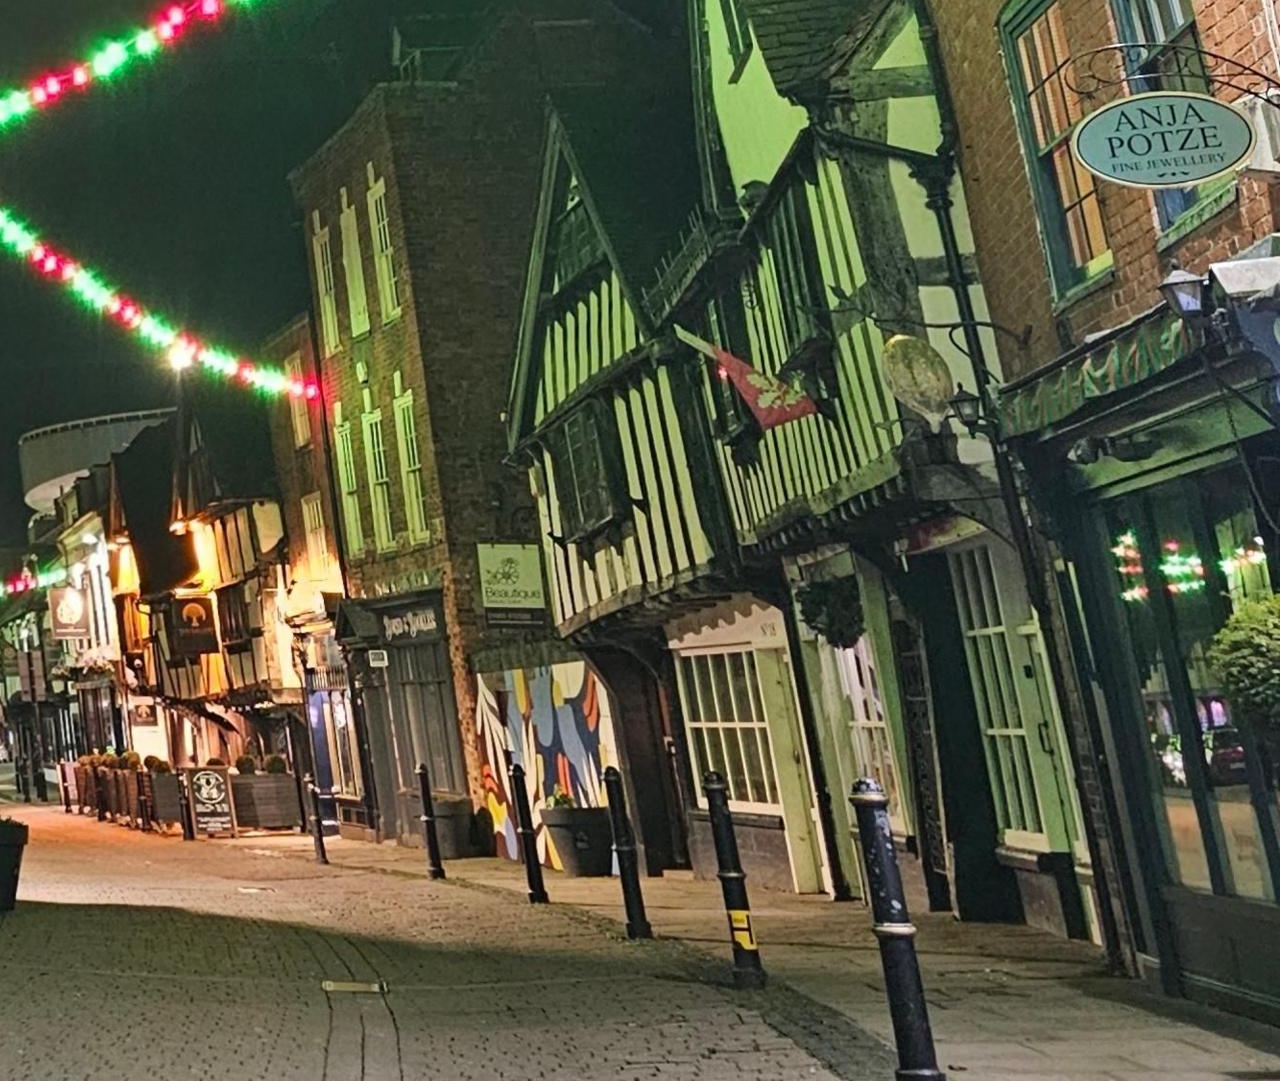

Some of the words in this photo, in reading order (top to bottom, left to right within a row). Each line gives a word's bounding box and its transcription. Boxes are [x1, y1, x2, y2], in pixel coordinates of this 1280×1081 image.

[1113, 101, 1208, 133] ANJA
[1104, 125, 1223, 159] POTZE
[1111, 160, 1140, 174] FINE
[1146, 151, 1227, 170] JEWELLERY
